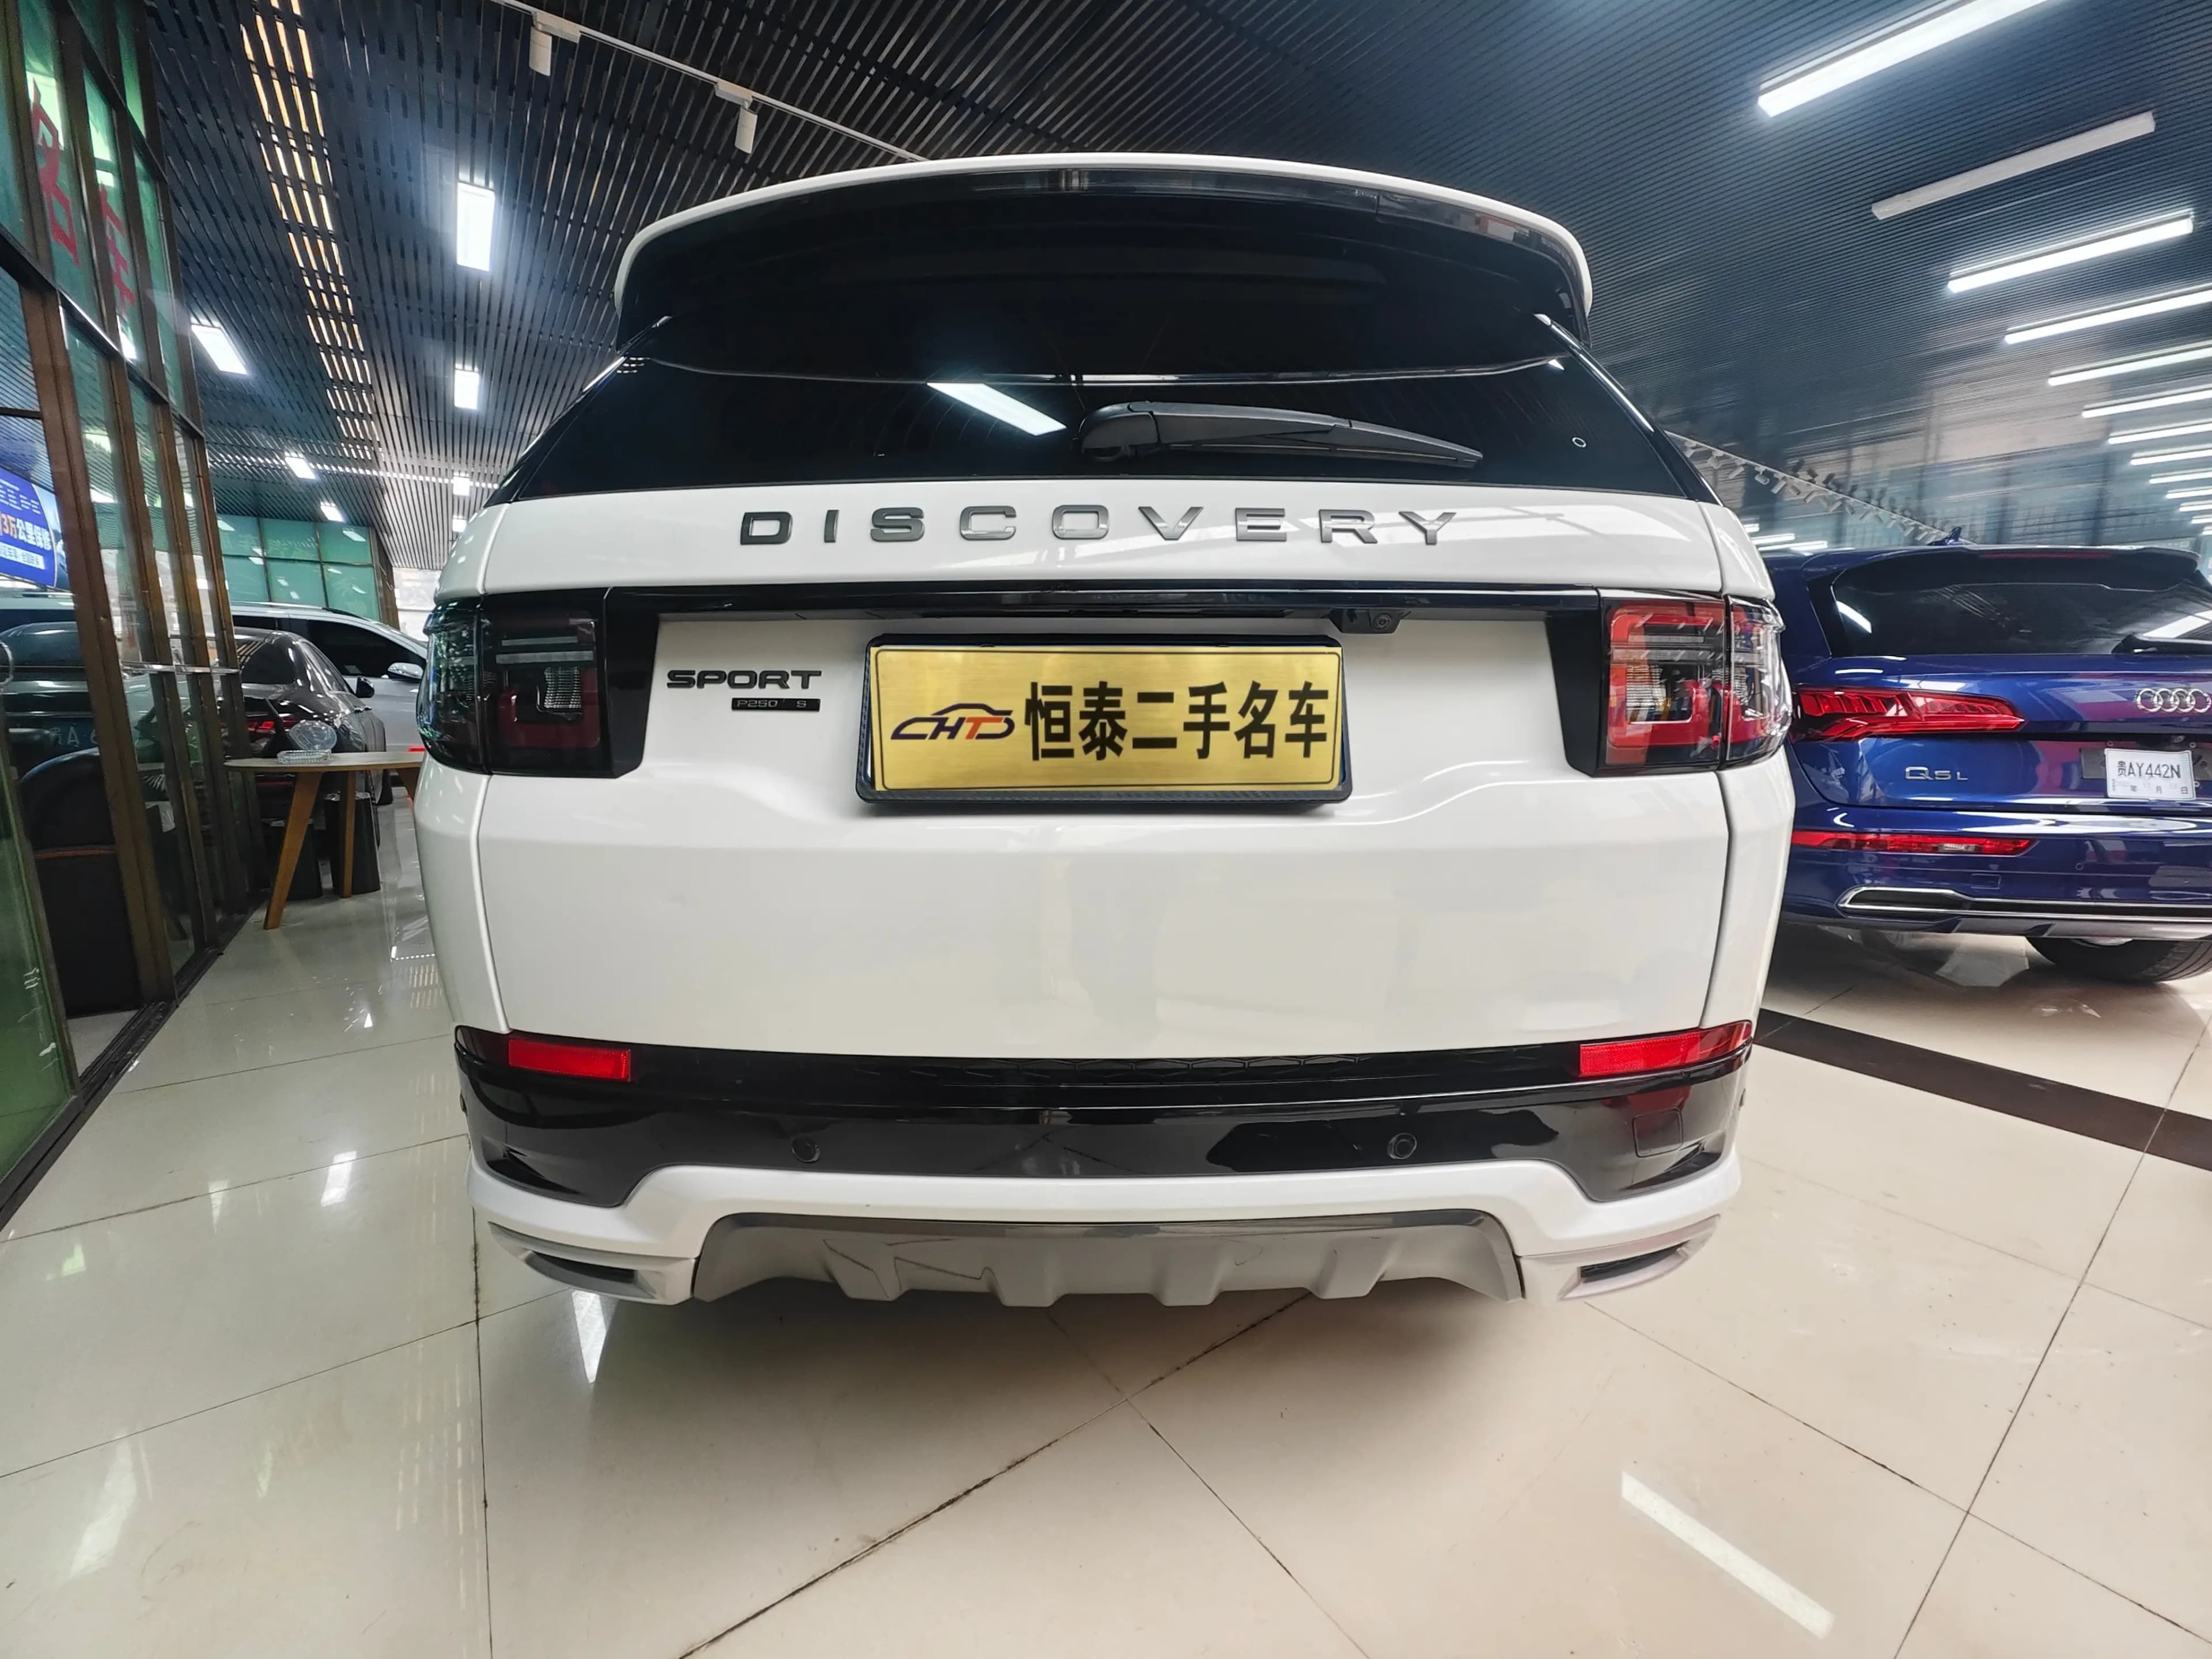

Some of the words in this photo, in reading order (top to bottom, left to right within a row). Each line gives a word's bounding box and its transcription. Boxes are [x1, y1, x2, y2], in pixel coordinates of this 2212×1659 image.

[740, 505, 1456, 546] DISCOVERY
[667, 670, 822, 689] SPORT
[737, 700, 778, 708] P250
[1024, 680, 1330, 761] 恒泰二手名车
[2117, 760, 2181, 778] 贵AY442N
